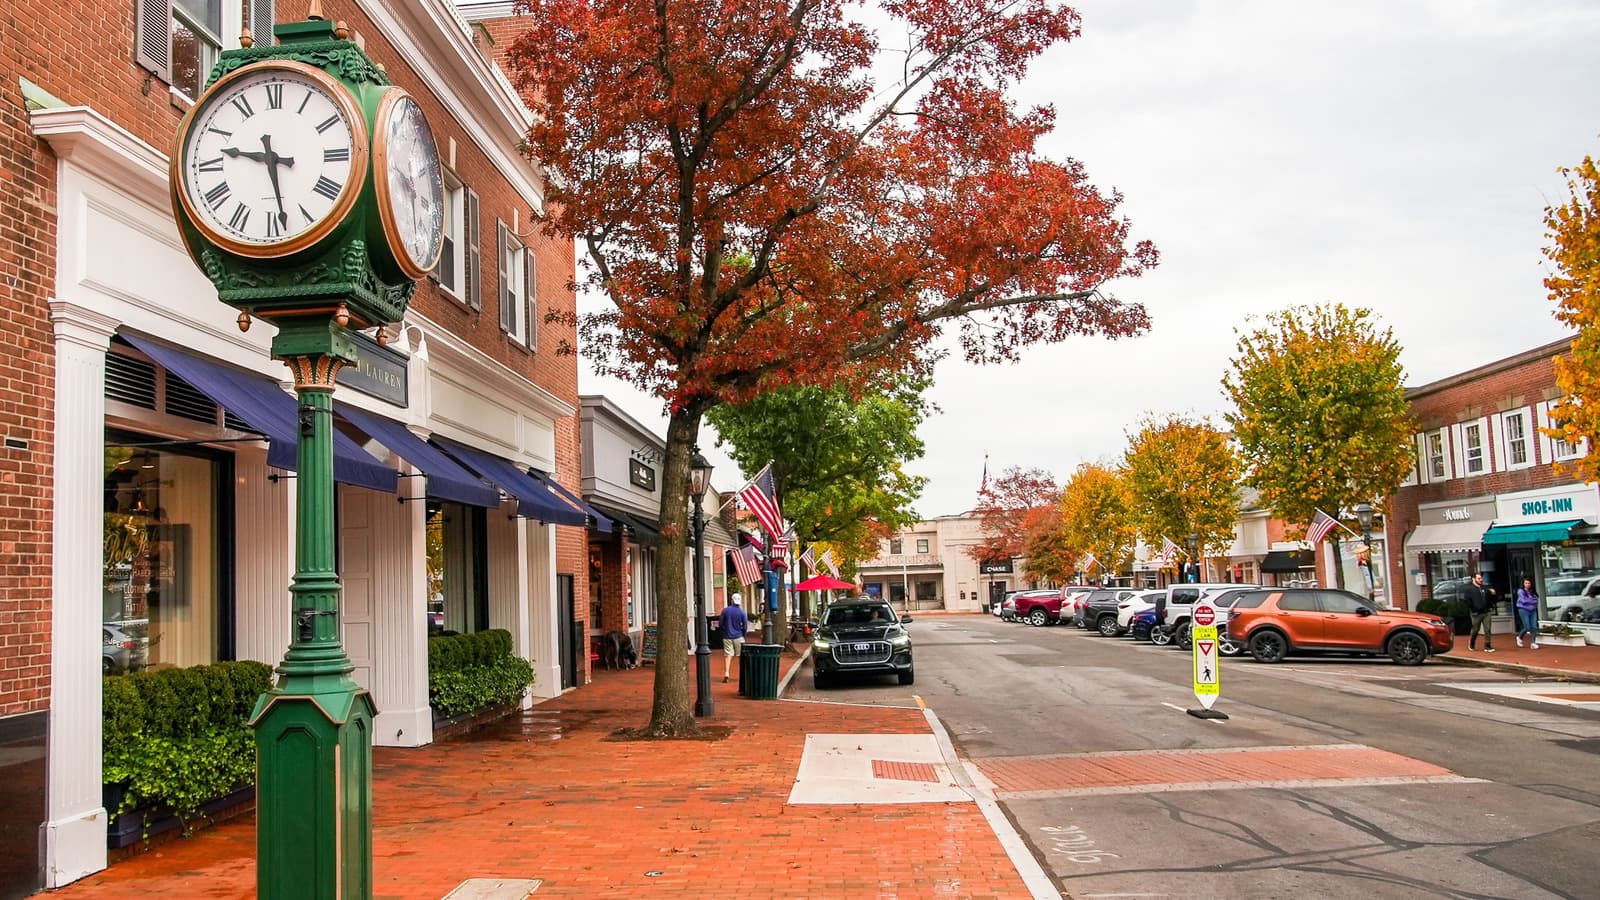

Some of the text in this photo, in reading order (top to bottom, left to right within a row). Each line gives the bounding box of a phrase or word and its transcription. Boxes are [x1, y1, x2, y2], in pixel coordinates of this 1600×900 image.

[231, 94, 254, 122] XI
[265, 84, 283, 110] XII
[296, 90, 313, 115] I
[207, 122, 233, 144] X
[315, 114, 341, 135] II
[199, 157, 224, 172] IX
[323, 148, 350, 162] III
[204, 181, 232, 212] VIII
[228, 202, 251, 232] VII
[298, 203, 316, 227] V
[366, 363, 401, 390] LAUREN
[1521, 497, 1572, 516] SHOE-INN
